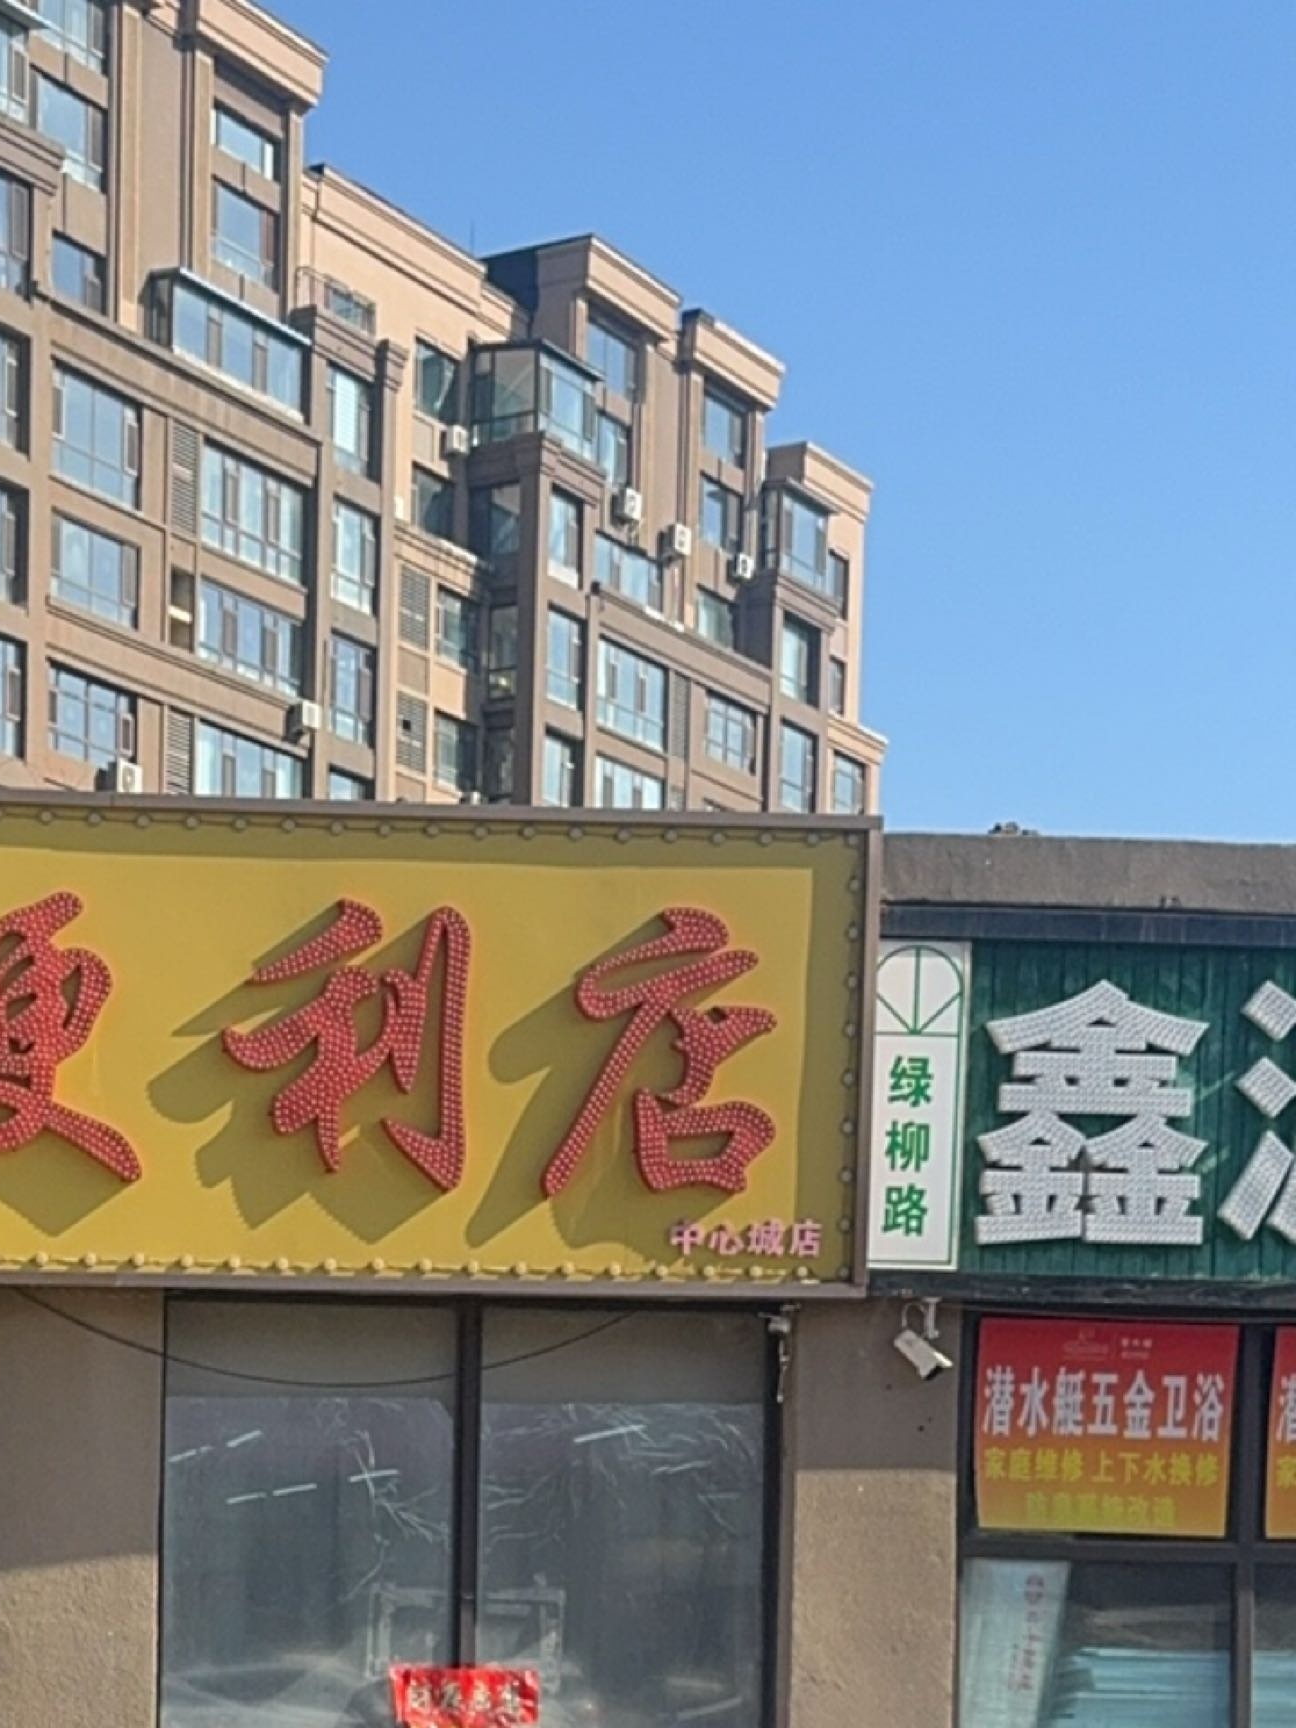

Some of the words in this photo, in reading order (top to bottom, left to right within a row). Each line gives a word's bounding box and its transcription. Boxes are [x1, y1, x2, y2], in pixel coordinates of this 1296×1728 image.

[881, 1055, 936, 1238] 绿柳路
[670, 1218, 823, 1257] 中心城店
[982, 1365, 1225, 1441] 潜水艇五金卫浴
